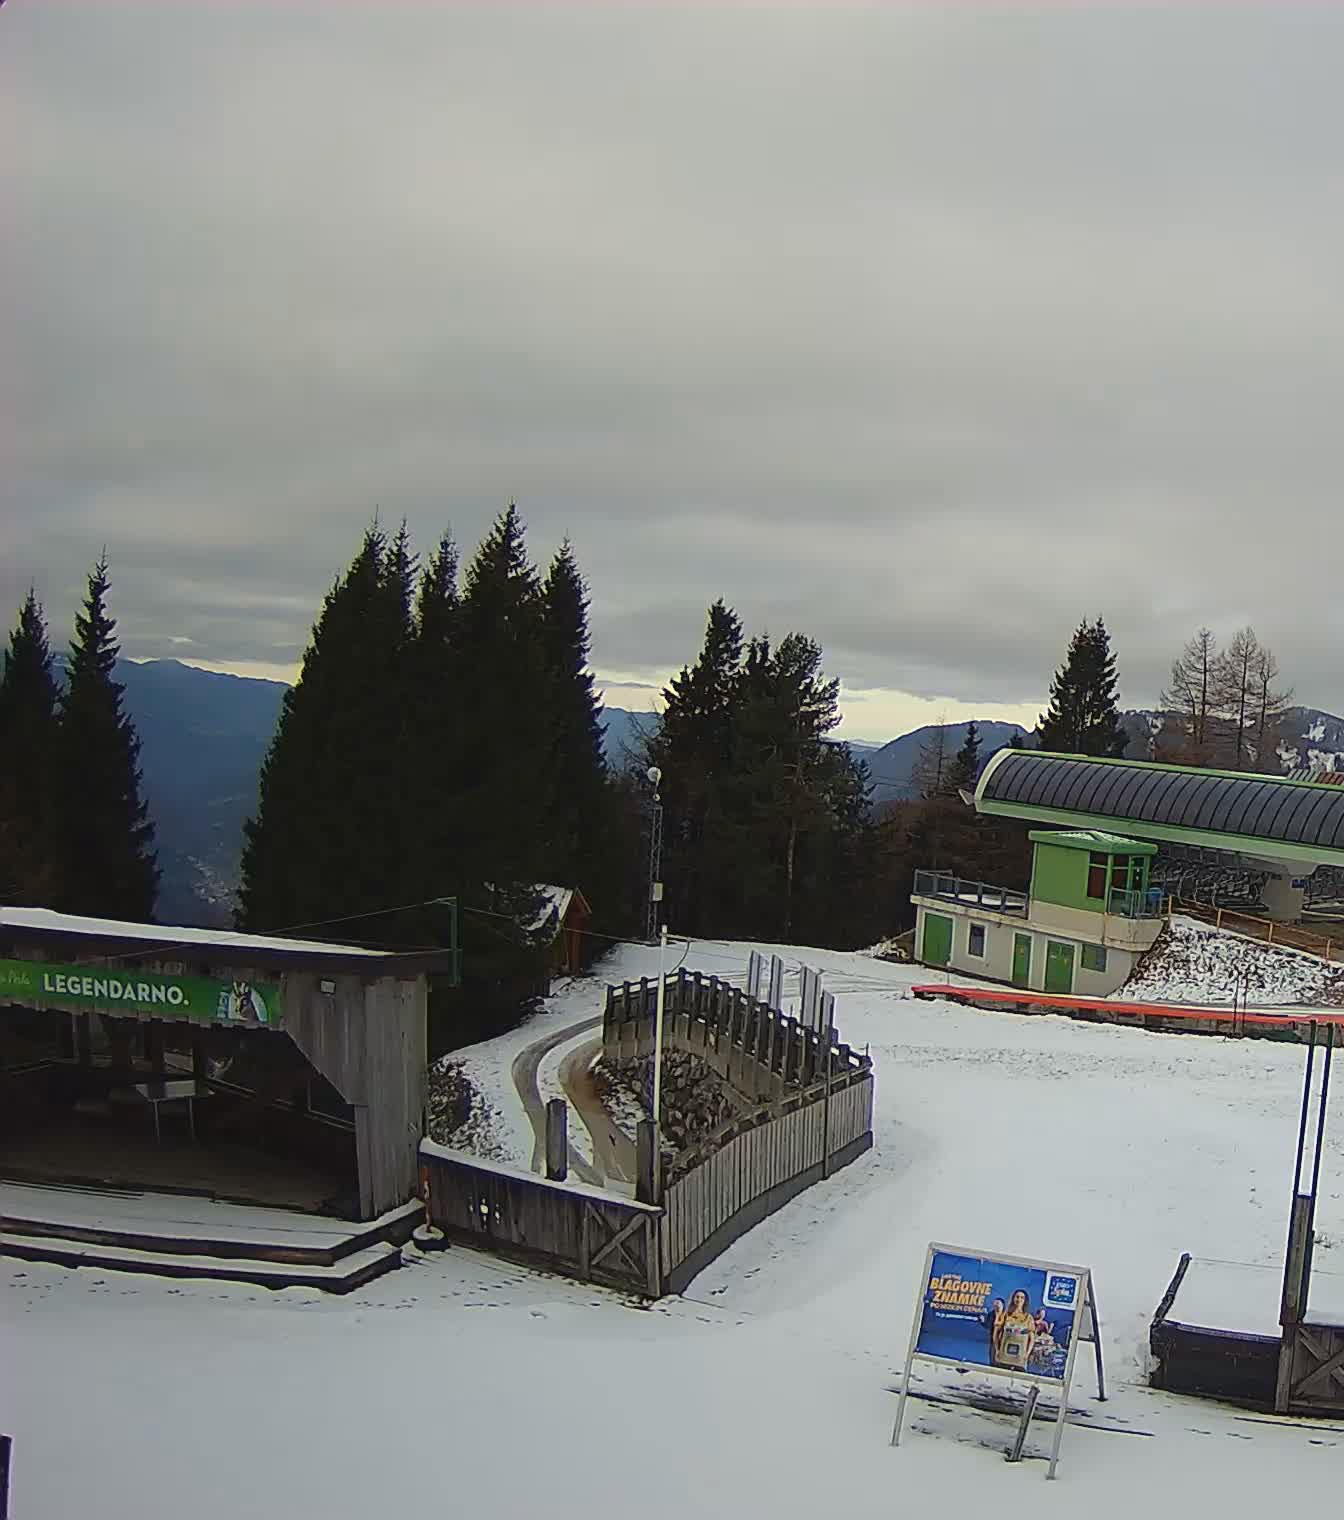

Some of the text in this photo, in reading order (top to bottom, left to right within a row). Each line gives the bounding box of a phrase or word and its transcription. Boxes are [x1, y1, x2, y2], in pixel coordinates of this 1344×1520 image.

[43, 973, 190, 1006] LEGENDARNO.
[930, 1276, 992, 1295] BLAGOVNE
[932, 1290, 986, 1306] ZNAMKE
